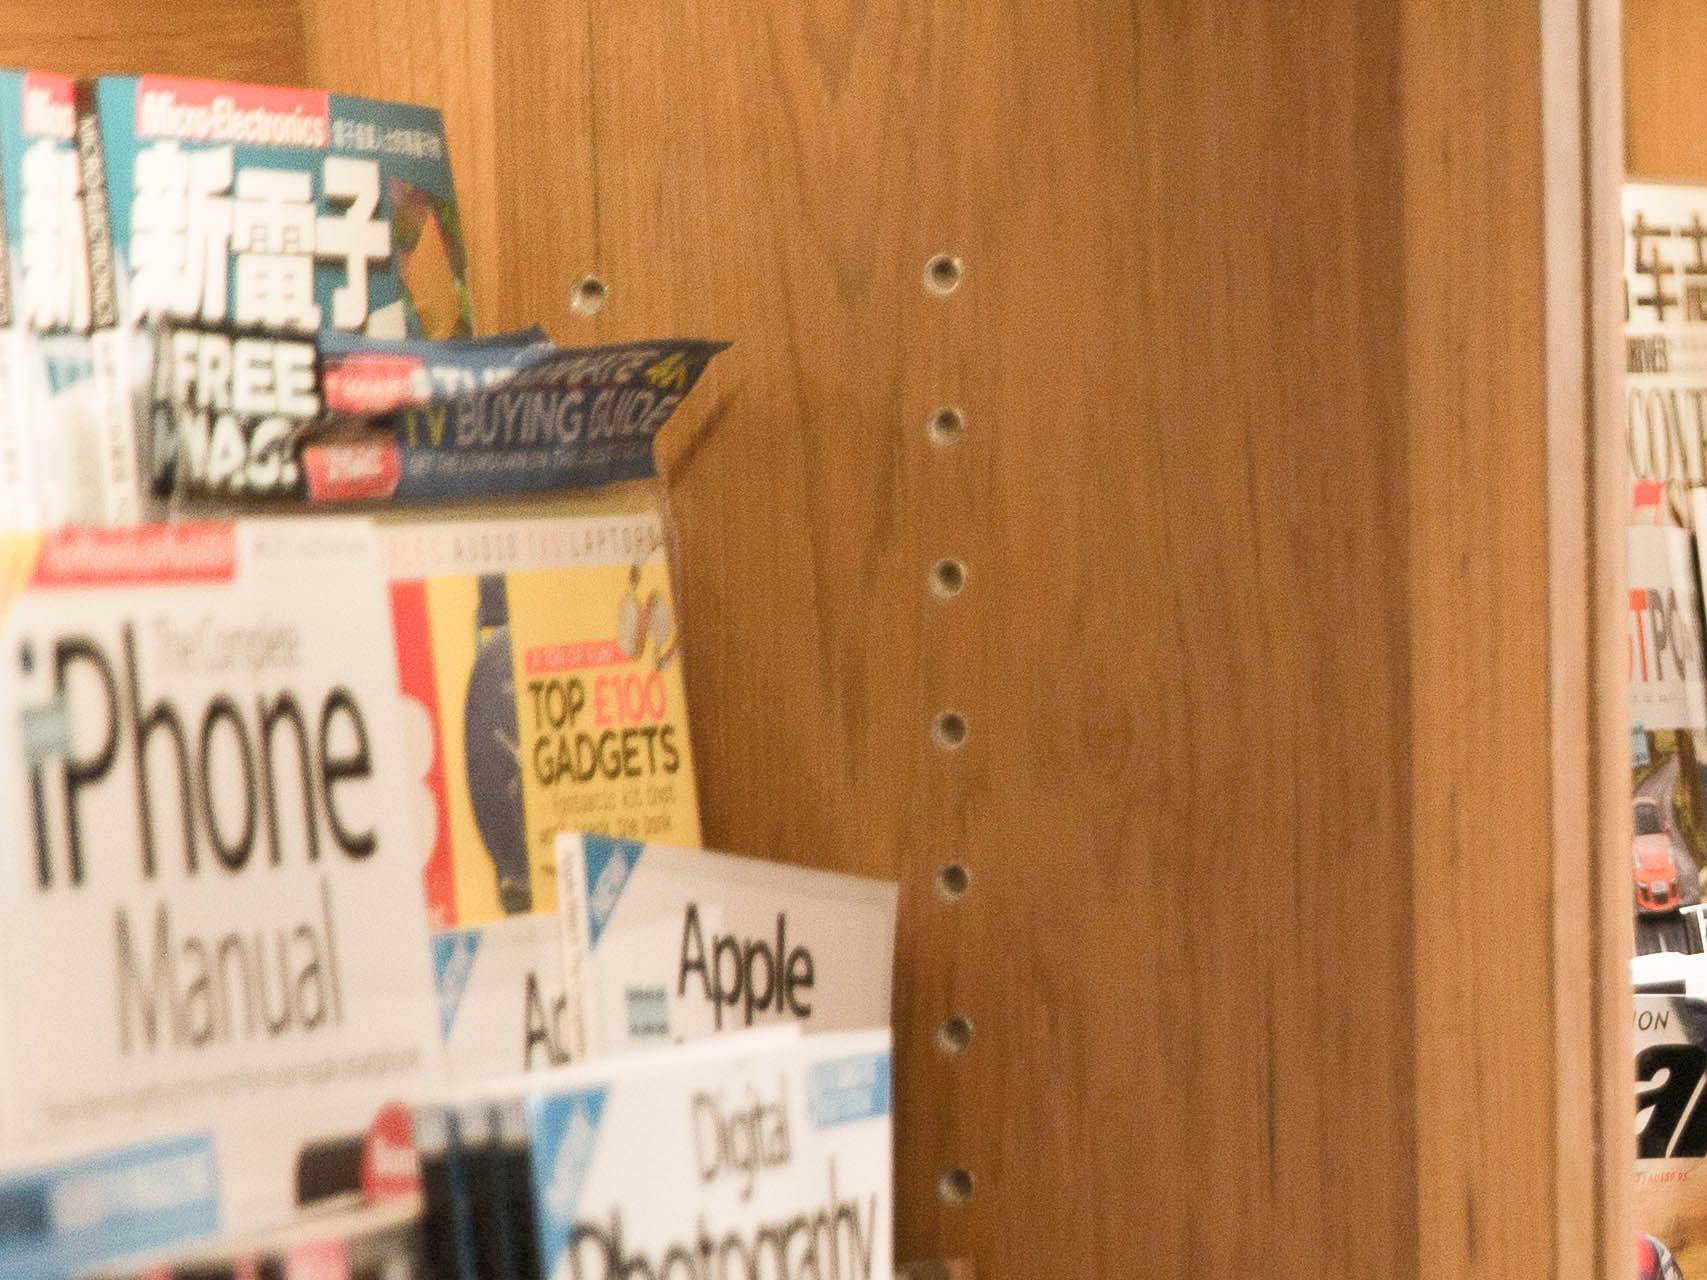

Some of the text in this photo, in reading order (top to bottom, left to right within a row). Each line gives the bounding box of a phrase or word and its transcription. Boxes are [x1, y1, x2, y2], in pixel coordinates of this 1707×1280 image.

[173, 328, 324, 414] FREE
[454, 388, 583, 448] BUYING
[17, 619, 378, 893] iPhone
[530, 676, 585, 731] TOP
[532, 723, 681, 787] GADGETS
[114, 871, 345, 1056] Manual
[677, 901, 814, 1032] Apple
[691, 1073, 791, 1203] Digital
